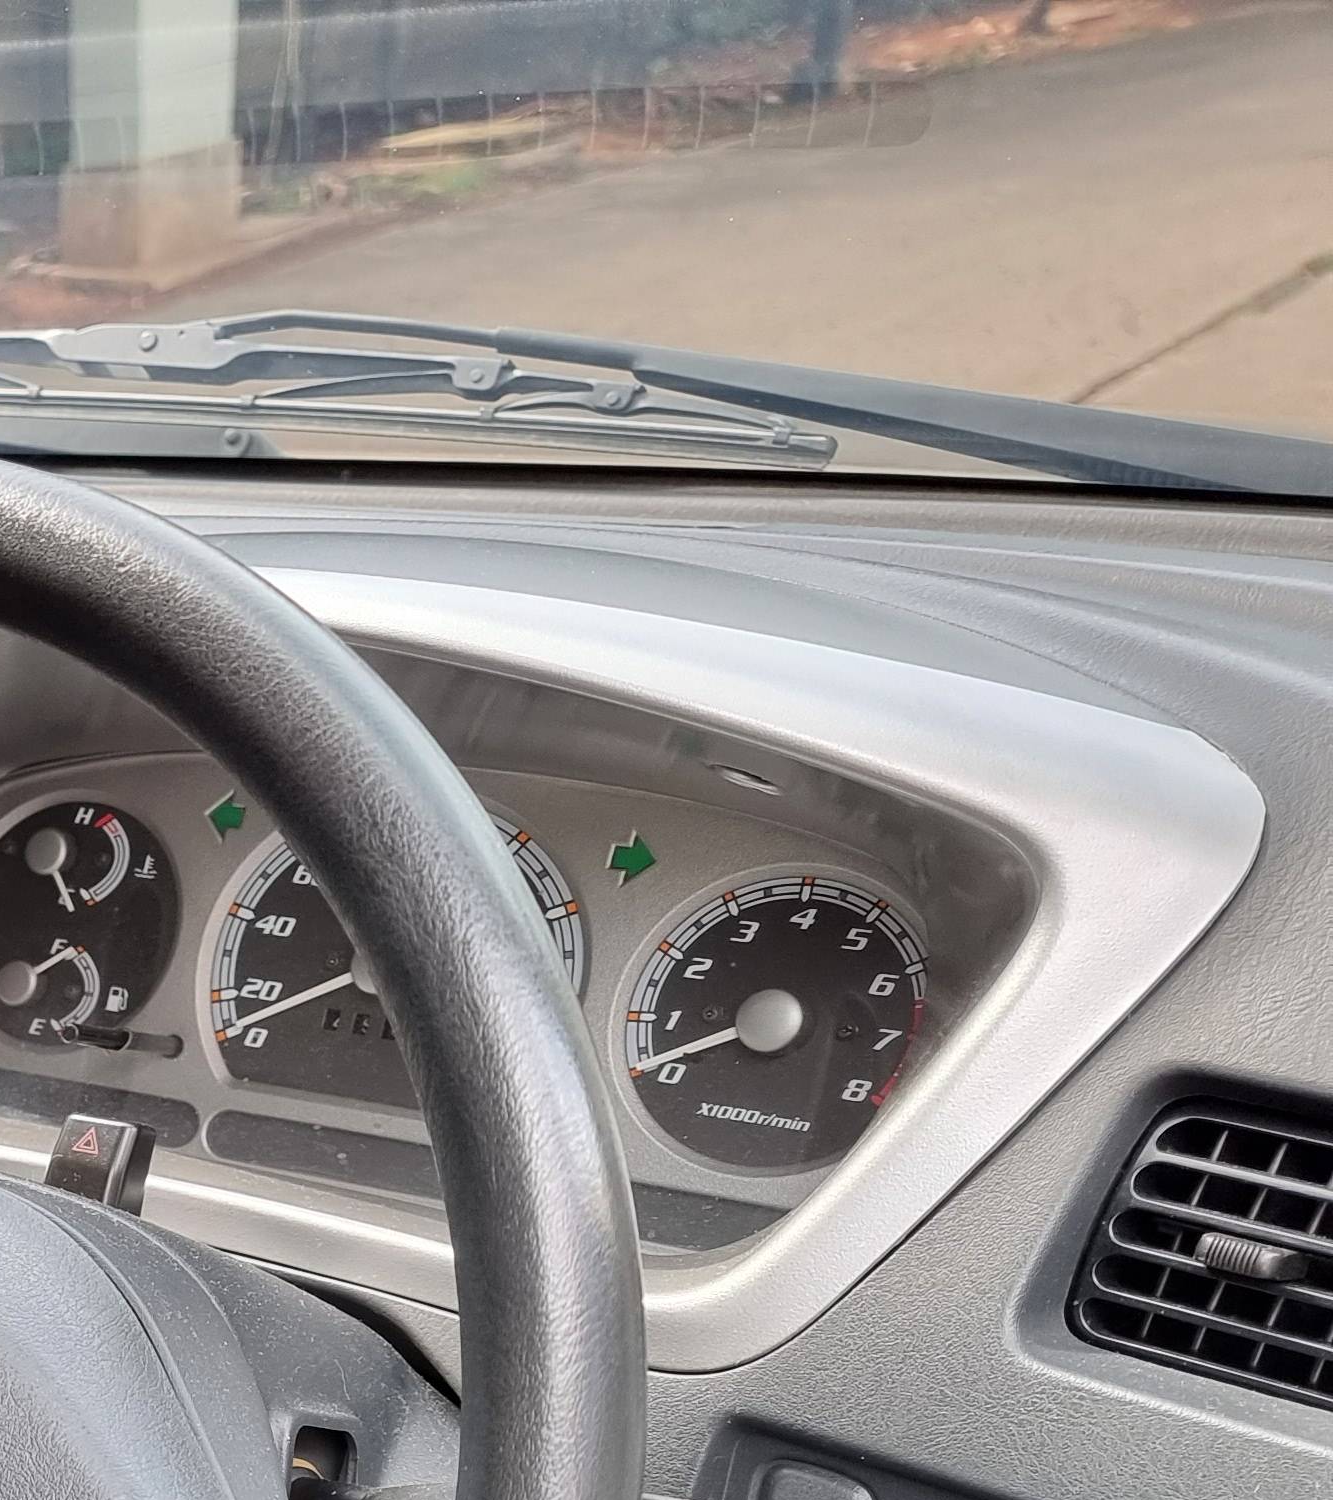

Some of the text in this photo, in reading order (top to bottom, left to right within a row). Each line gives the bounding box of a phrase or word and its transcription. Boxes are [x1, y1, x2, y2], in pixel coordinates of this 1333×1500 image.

[74, 807, 94, 825] H
[254, 914, 297, 938] 40
[789, 908, 818, 930] 4
[730, 920, 761, 943] 3
[840, 928, 873, 951] 5
[50, 938, 69, 955] F
[683, 957, 713, 980] 2
[240, 978, 284, 1002] 20
[868, 973, 899, 996] 6
[28, 1018, 47, 1036] E
[664, 1010, 682, 1031] 1
[243, 1027, 269, 1049] 0
[871, 1028, 903, 1051] 7
[657, 1063, 687, 1085] 0
[841, 1079, 873, 1102] 8
